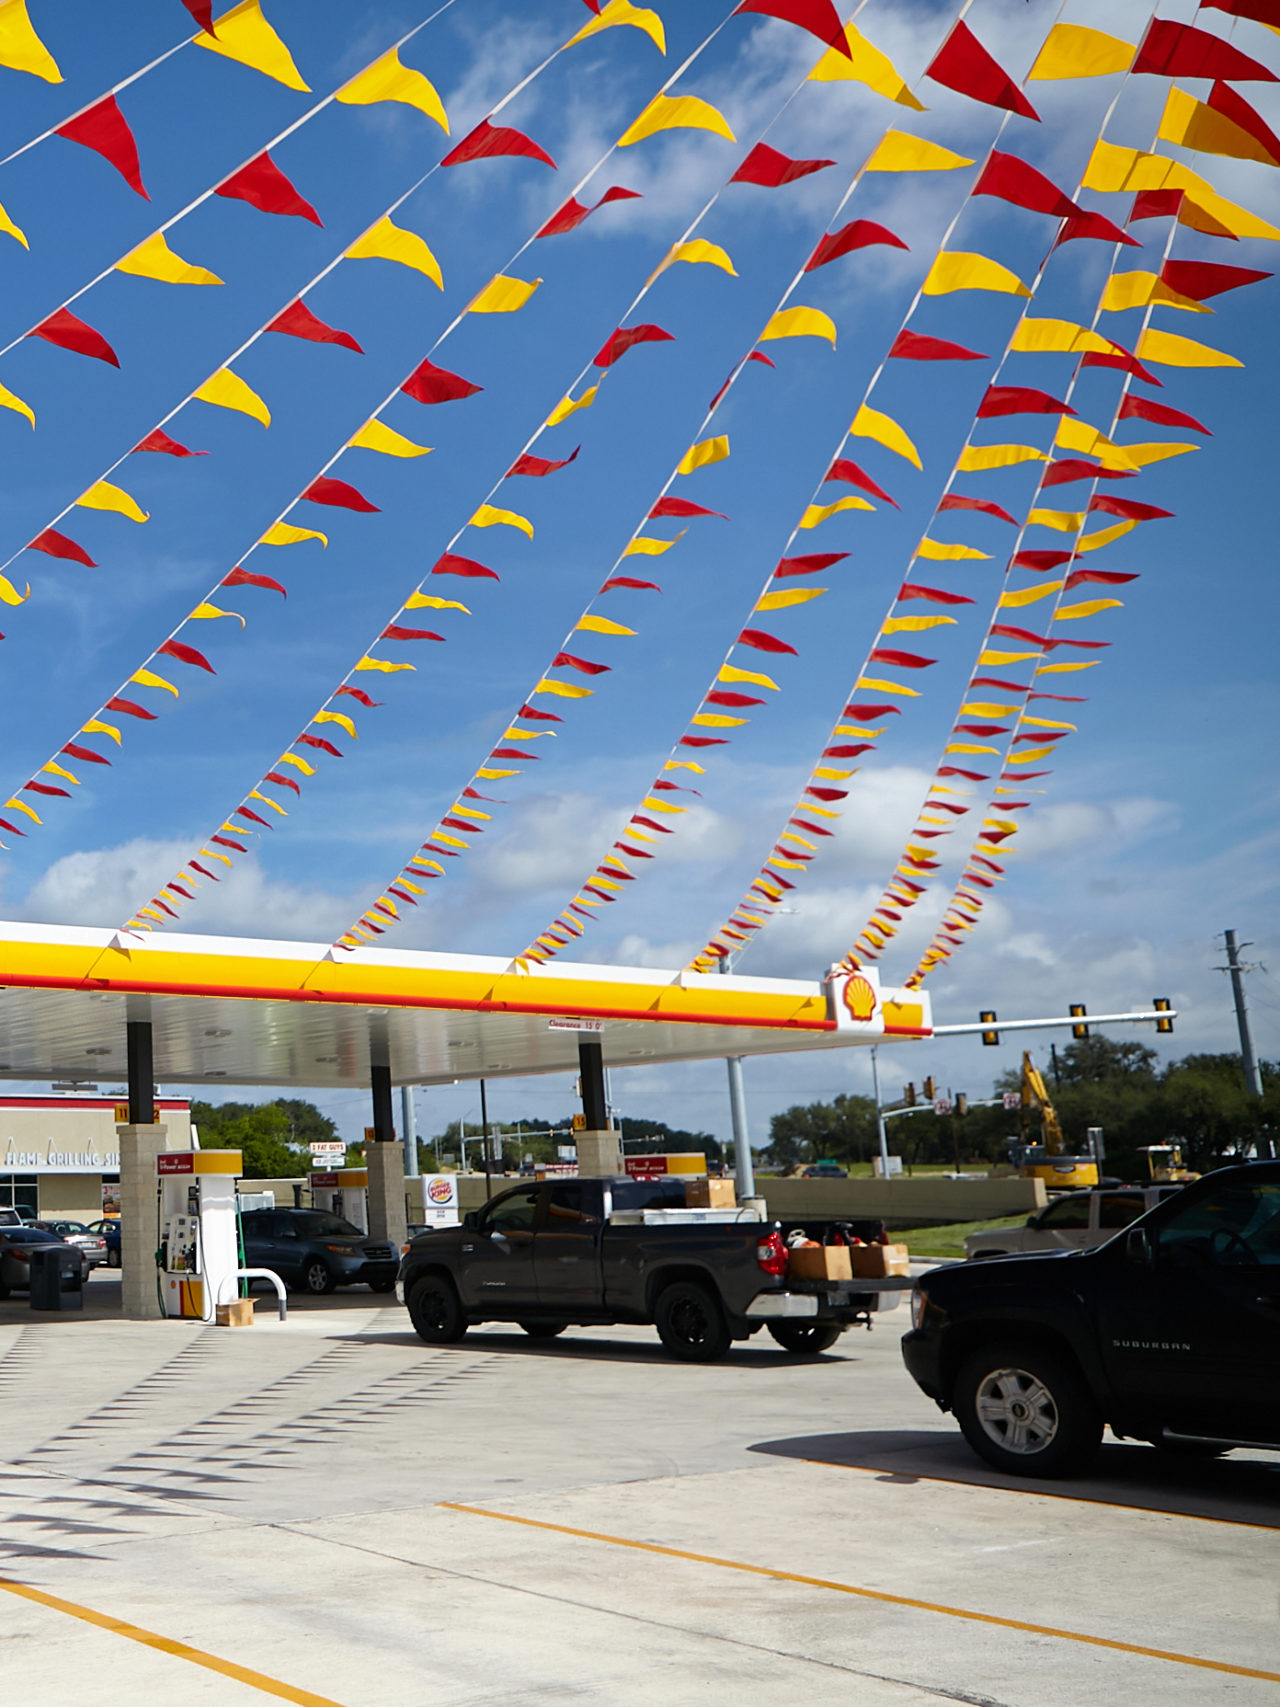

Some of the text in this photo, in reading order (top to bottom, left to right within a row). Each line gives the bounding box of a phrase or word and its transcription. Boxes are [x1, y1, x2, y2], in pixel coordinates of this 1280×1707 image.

[119, 1108, 128, 1119] 11
[6, 1152, 42, 1165] FLAME
[48, 1152, 99, 1165] GRILLING
[1113, 1340, 1191, 1350] SUBURBAN
